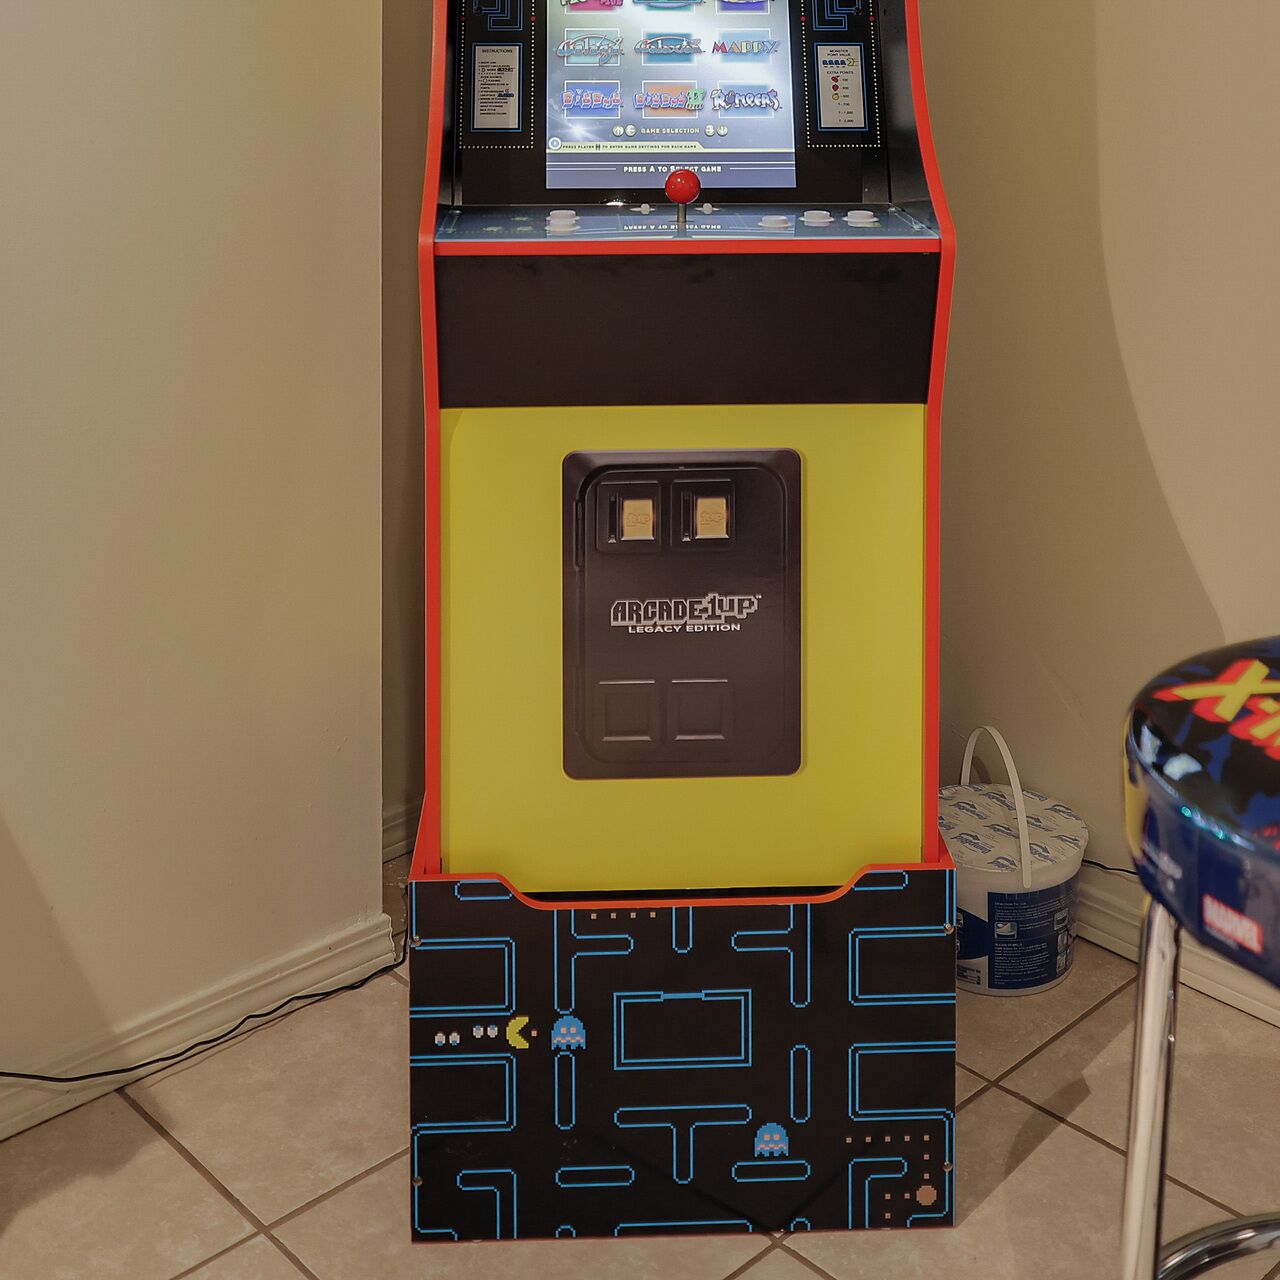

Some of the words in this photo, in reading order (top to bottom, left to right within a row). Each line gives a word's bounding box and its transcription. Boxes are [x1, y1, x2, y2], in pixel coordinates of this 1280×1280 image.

[649, 165, 655, 173] A
[628, 625, 682, 634] LEGACY
[685, 623, 741, 633] EDITION
